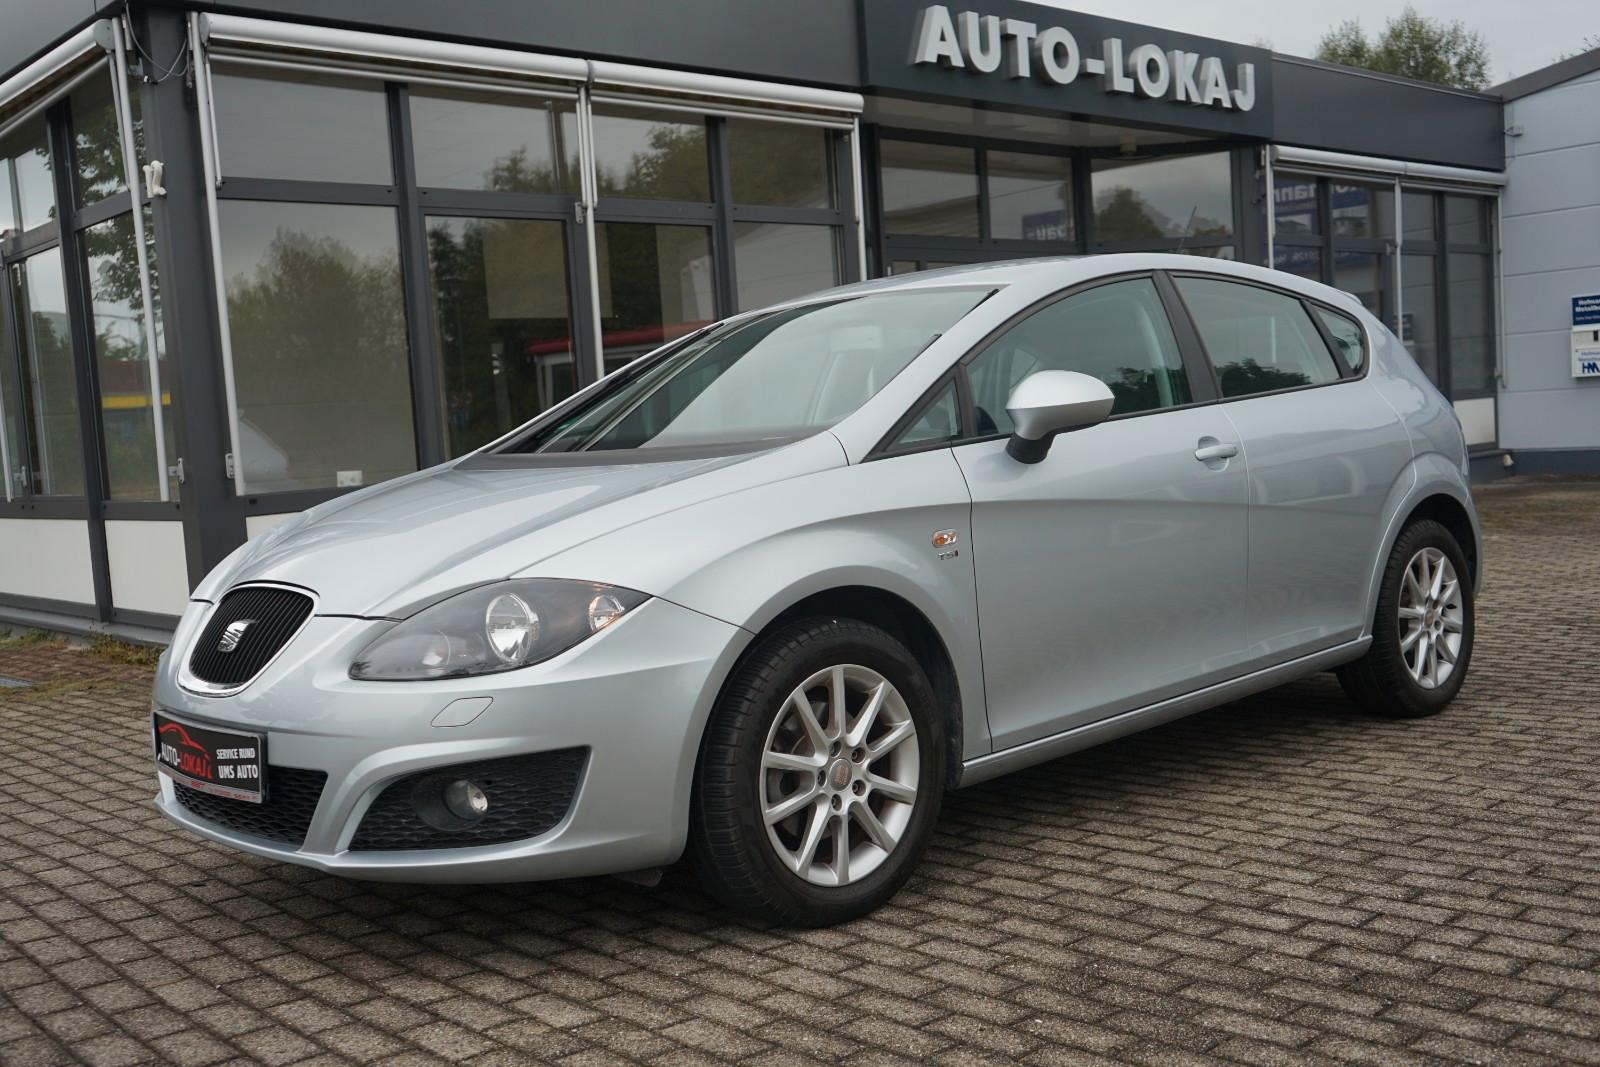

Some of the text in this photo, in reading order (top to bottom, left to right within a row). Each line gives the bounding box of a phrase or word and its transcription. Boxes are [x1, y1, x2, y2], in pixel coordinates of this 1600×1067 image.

[913, 3, 1255, 112] AUTO-LOKAJ
[160, 742, 207, 778] AUTO-LOKAJ
[216, 747, 256, 760] SERVICE RUND
[218, 764, 259, 779] UMS AUTO
